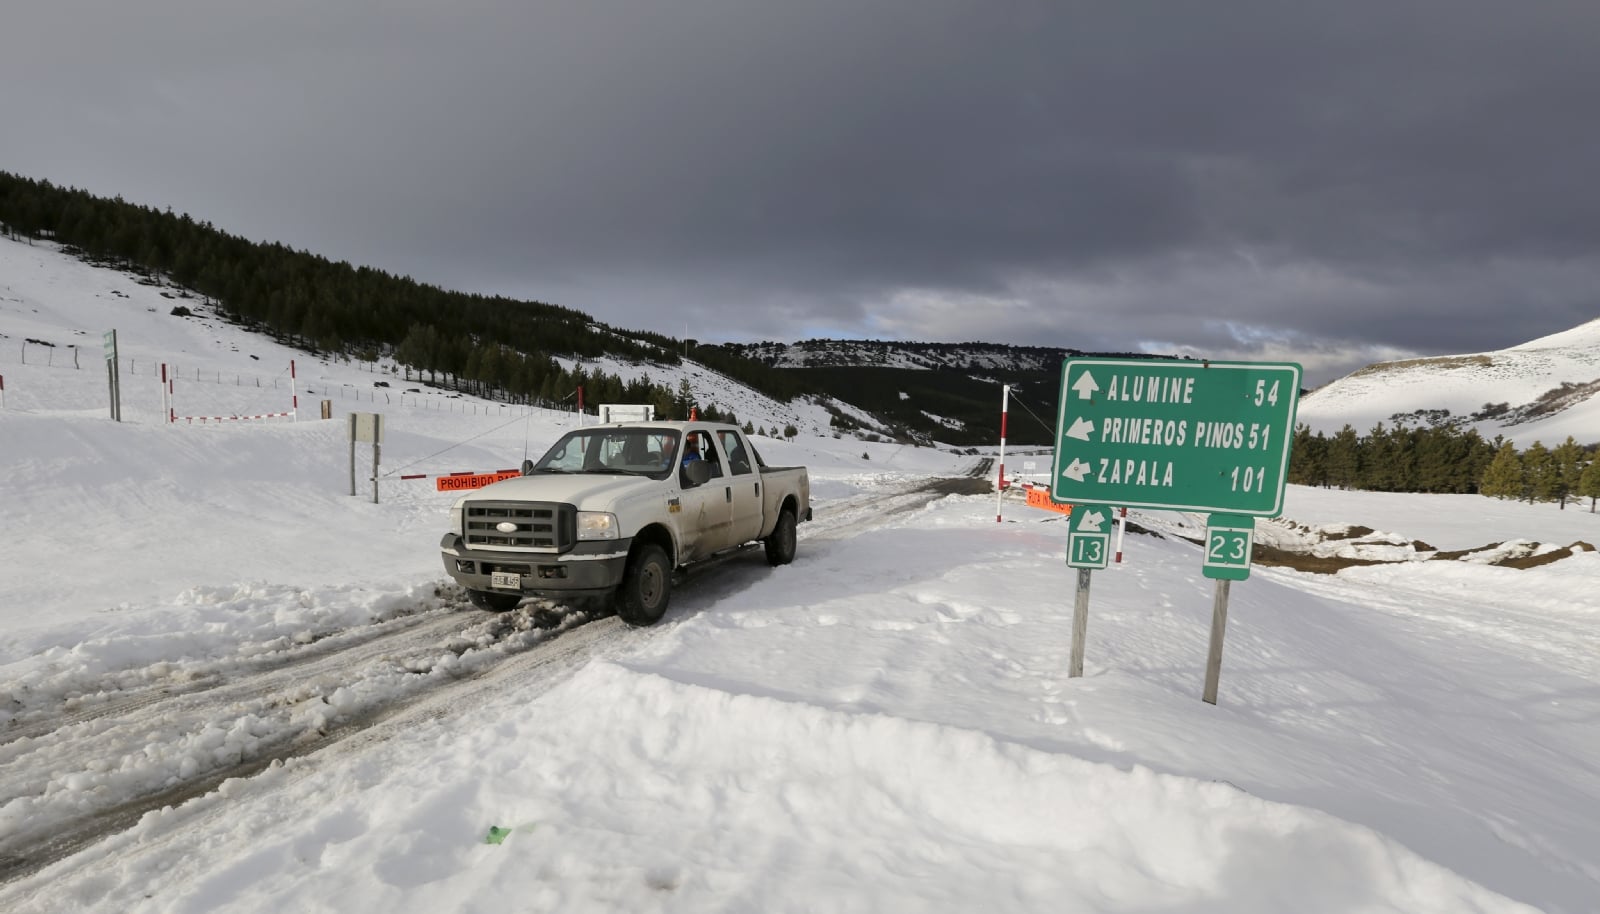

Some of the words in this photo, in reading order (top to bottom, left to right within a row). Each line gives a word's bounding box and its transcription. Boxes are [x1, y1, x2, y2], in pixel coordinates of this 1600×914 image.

[1107, 375, 1195, 404] ALUMINE
[1254, 379, 1280, 407] 54
[1101, 417, 1187, 446] PRIMEROS
[1194, 421, 1244, 449] PINOS
[1248, 423, 1270, 451] 51
[441, 476, 494, 489] PROHIBIDO
[1097, 458, 1173, 487] ZAPALA
[1231, 466, 1265, 493] 101
[1078, 539, 1101, 562] 13
[1210, 535, 1245, 559] 23
